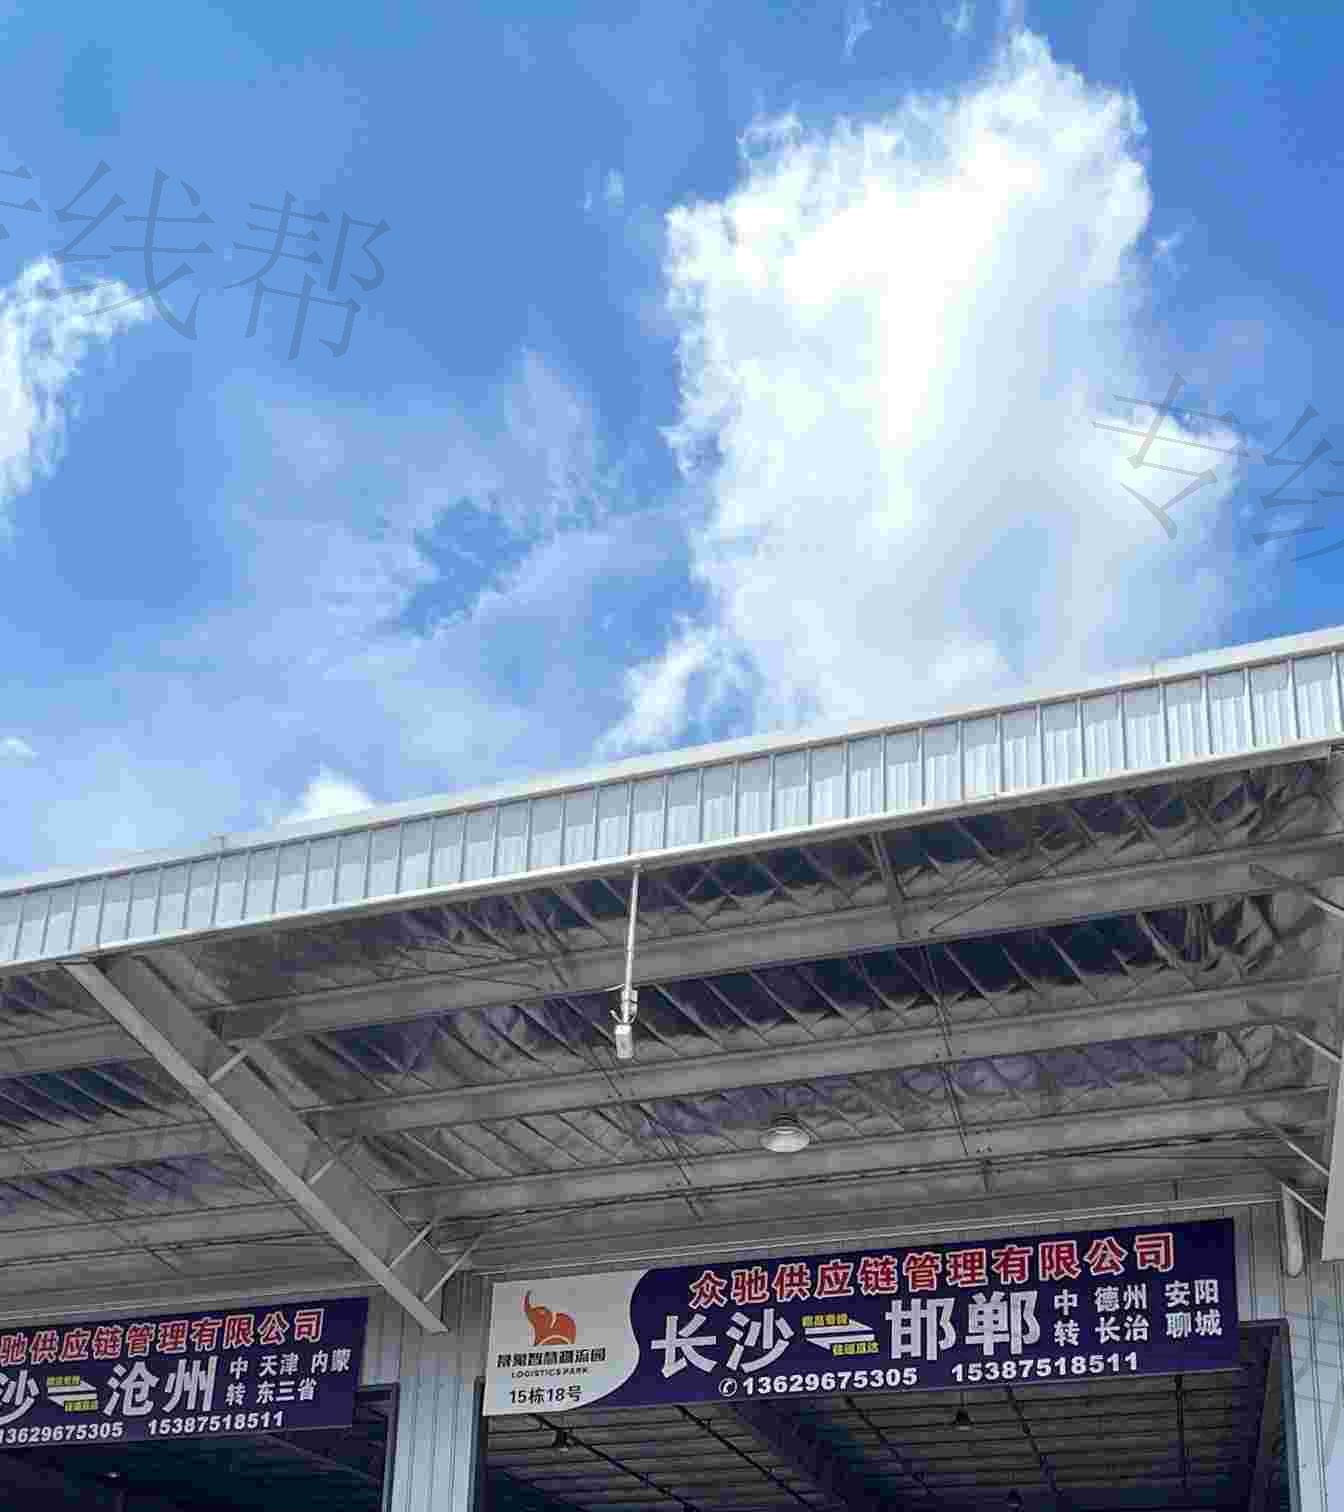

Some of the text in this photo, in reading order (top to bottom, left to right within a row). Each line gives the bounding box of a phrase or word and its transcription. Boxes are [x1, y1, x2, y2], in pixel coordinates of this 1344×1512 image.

[689, 1232, 1175, 1309] 众驰供应链管理有限公司
[1095, 1278, 1219, 1313] 德州 安阳
[651, 1290, 1041, 1378] 长沙 邯郸
[1095, 1308, 1223, 1344] 长治 聊城
[258, 1351, 299, 1377] 天津
[743, 1352, 1138, 1395] 13629675305 15387518511
[103, 1355, 220, 1416] 沧州
[511, 1385, 582, 1404] 15栋18号
[148, 1411, 285, 1436] 15387518511
